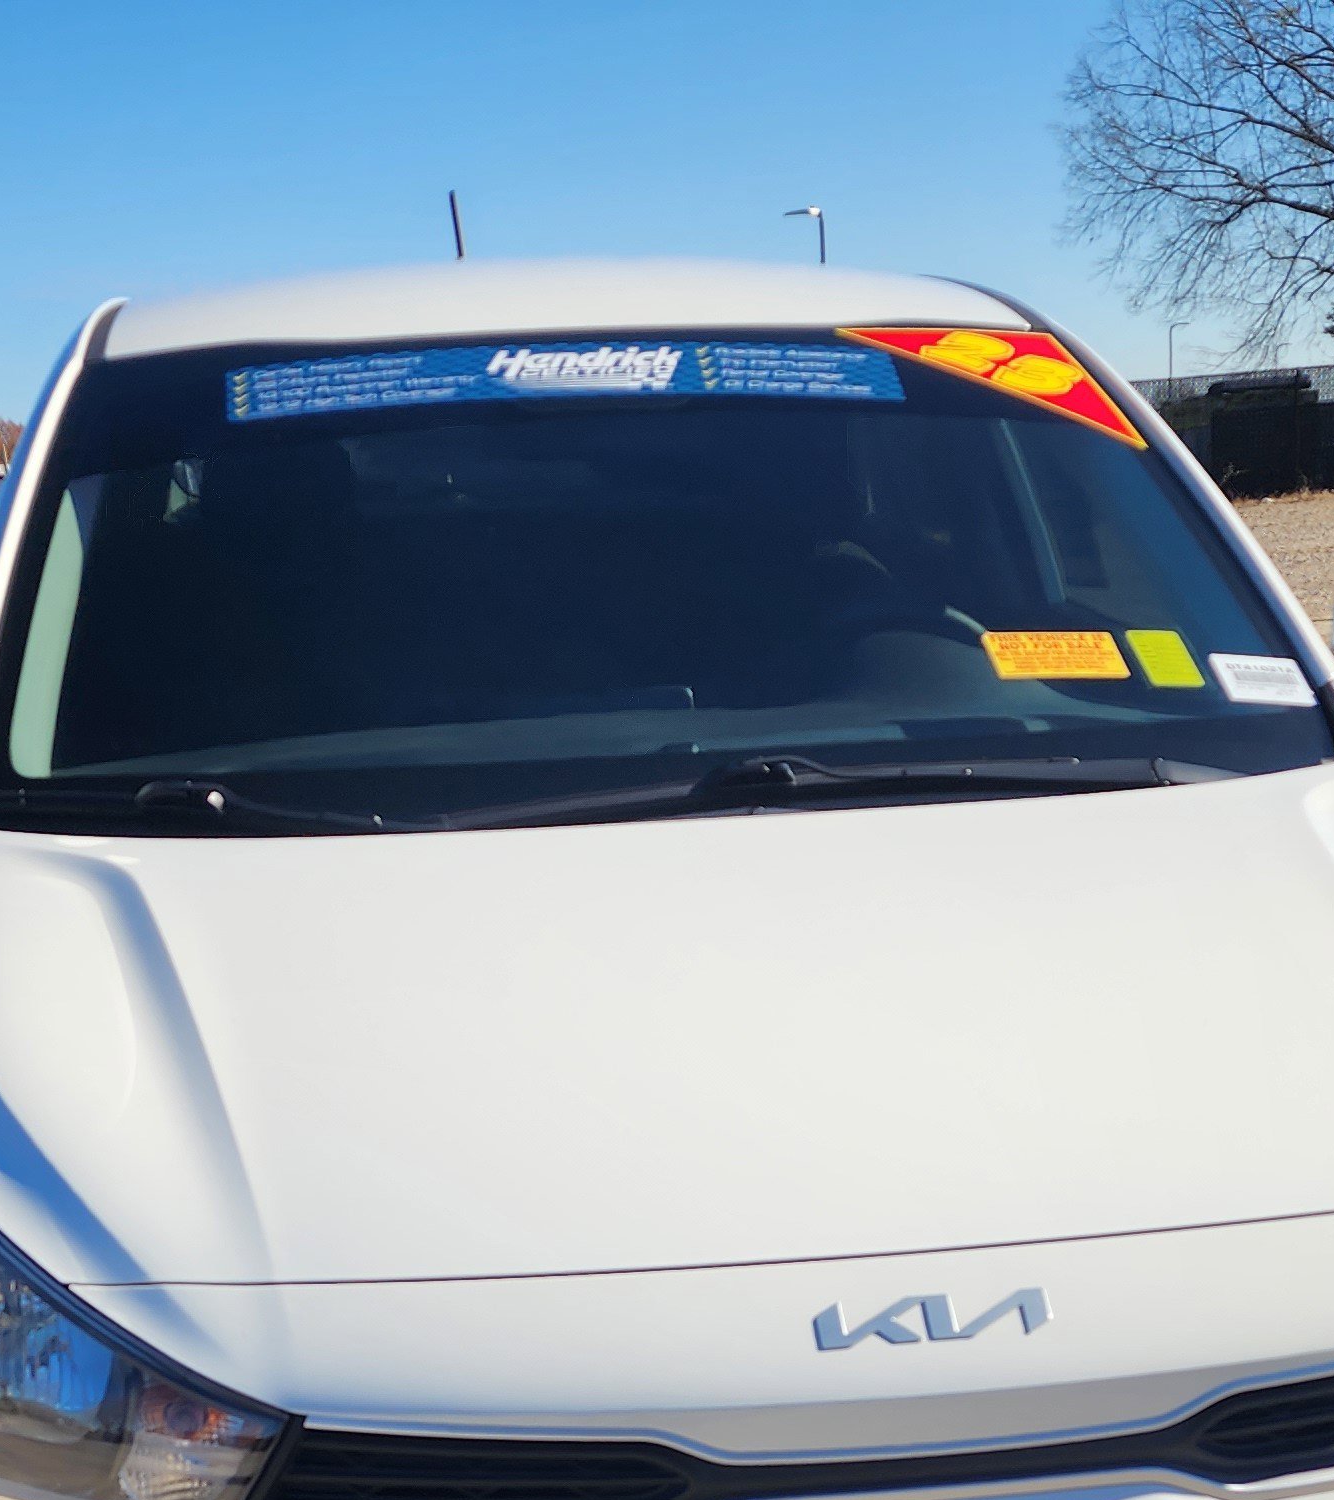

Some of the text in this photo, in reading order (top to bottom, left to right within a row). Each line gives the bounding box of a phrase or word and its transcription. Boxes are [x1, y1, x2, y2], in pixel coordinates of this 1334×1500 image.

[485, 346, 684, 382] Hendrick
[919, 330, 1085, 397] 23
[813, 1286, 1054, 1352] KIA
